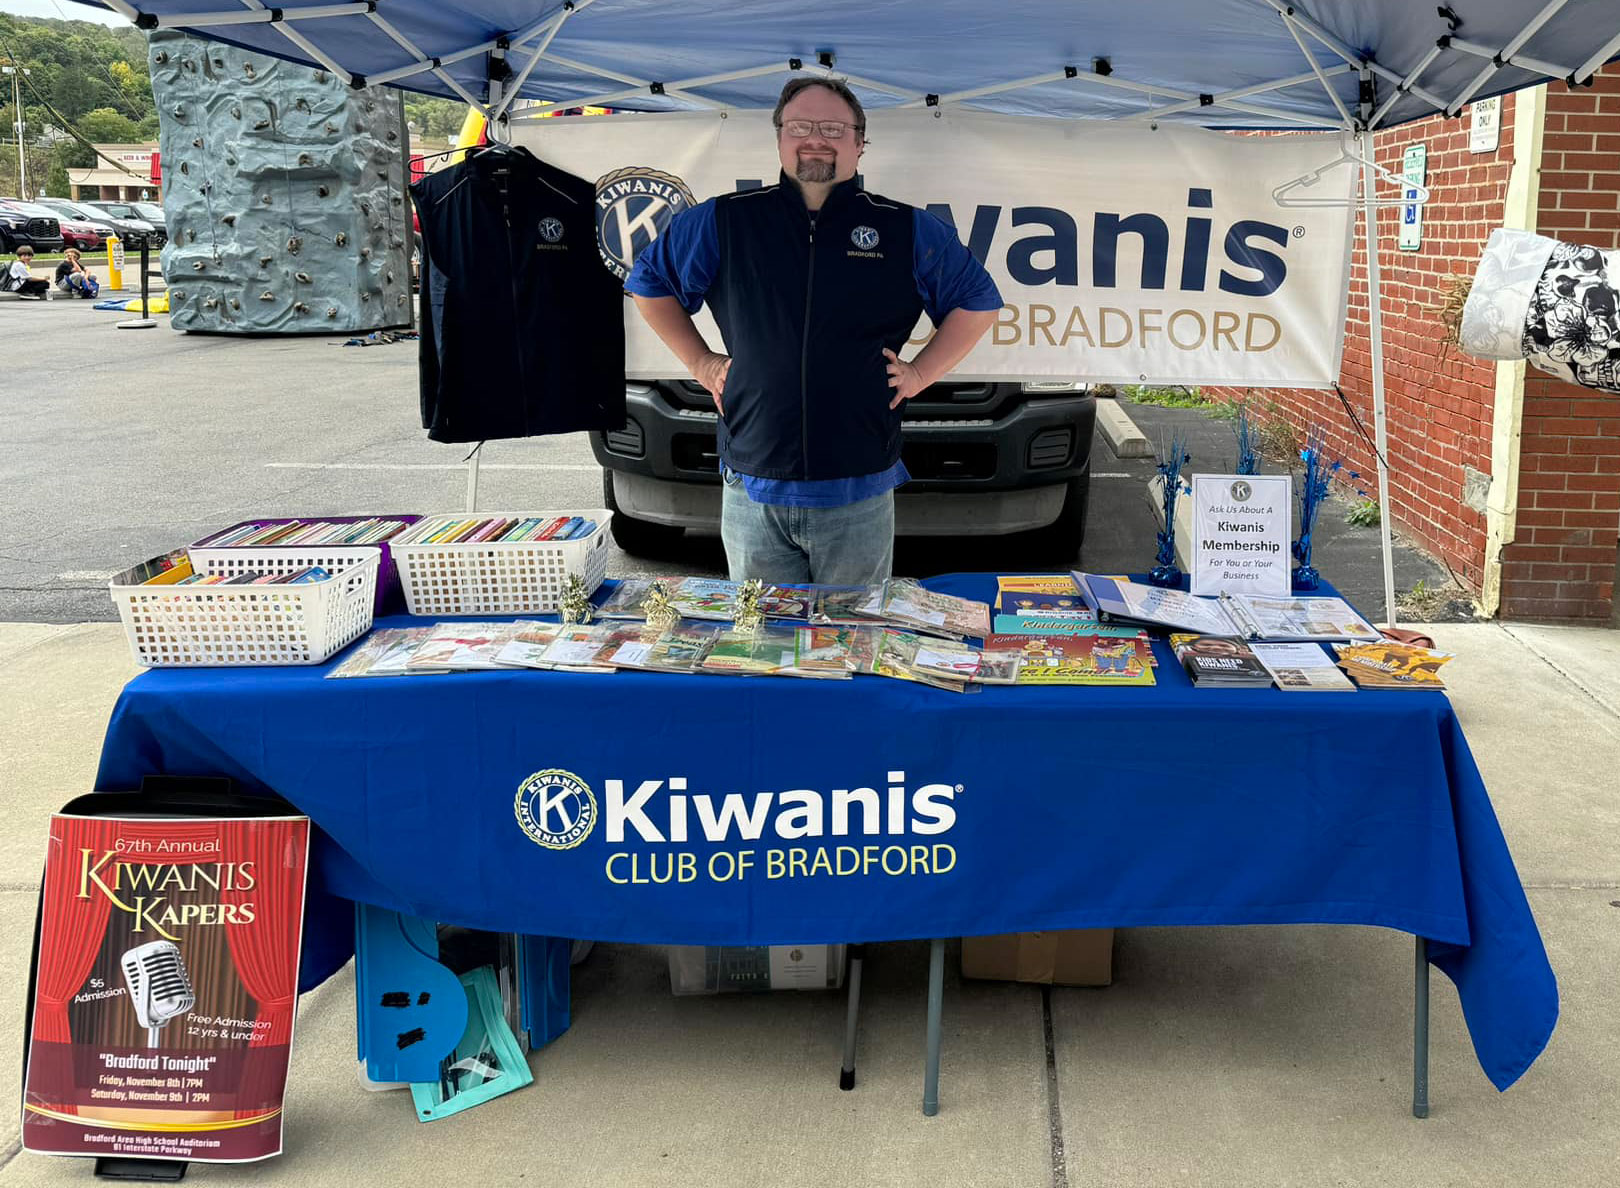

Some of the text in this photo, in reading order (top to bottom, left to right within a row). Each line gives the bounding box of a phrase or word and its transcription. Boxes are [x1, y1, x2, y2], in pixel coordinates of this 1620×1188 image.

[596, 179, 681, 209] KIWANIS
[735, 180, 1291, 297] anis
[992, 303, 1282, 352] BRADFORD
[1209, 505, 1224, 513] Ask
[1238, 506, 1265, 514] About
[1217, 521, 1265, 533] Kiwanis
[1202, 540, 1280, 554] Membership
[1209, 559, 1224, 567] For
[1225, 559, 1241, 567] You
[1254, 559, 1273, 568] Your
[1223, 571, 1260, 580] Business
[527, 775, 583, 794] KIWANIS
[604, 770, 957, 843] Kiwanis
[520, 801, 590, 843] INTERNATIONAL
[114, 838, 221, 854] 67th Annual
[605, 843, 957, 884] CLUB OF BRADFORD
[75, 848, 256, 913] KIWANIS
[131, 896, 256, 941] KAPERS
[74, 986, 127, 1004] Admission
[187, 1013, 272, 1030] Free Admission
[187, 1026, 265, 1041] 12 yrs & under
[99, 1075, 125, 1087] Friday,
[126, 1076, 165, 1087] November
[186, 1078, 203, 1088] 7PM
[91, 1089, 127, 1101] Saturday,
[128, 1091, 168, 1101] November
[169, 1091, 182, 1102] 9th
[192, 1092, 210, 1103] 2PM
[84, 1134, 221, 1148] Bradford Area High School Auditorium
[123, 1144, 159, 1153] Interstate
[160, 1145, 192, 1156] Parkway
